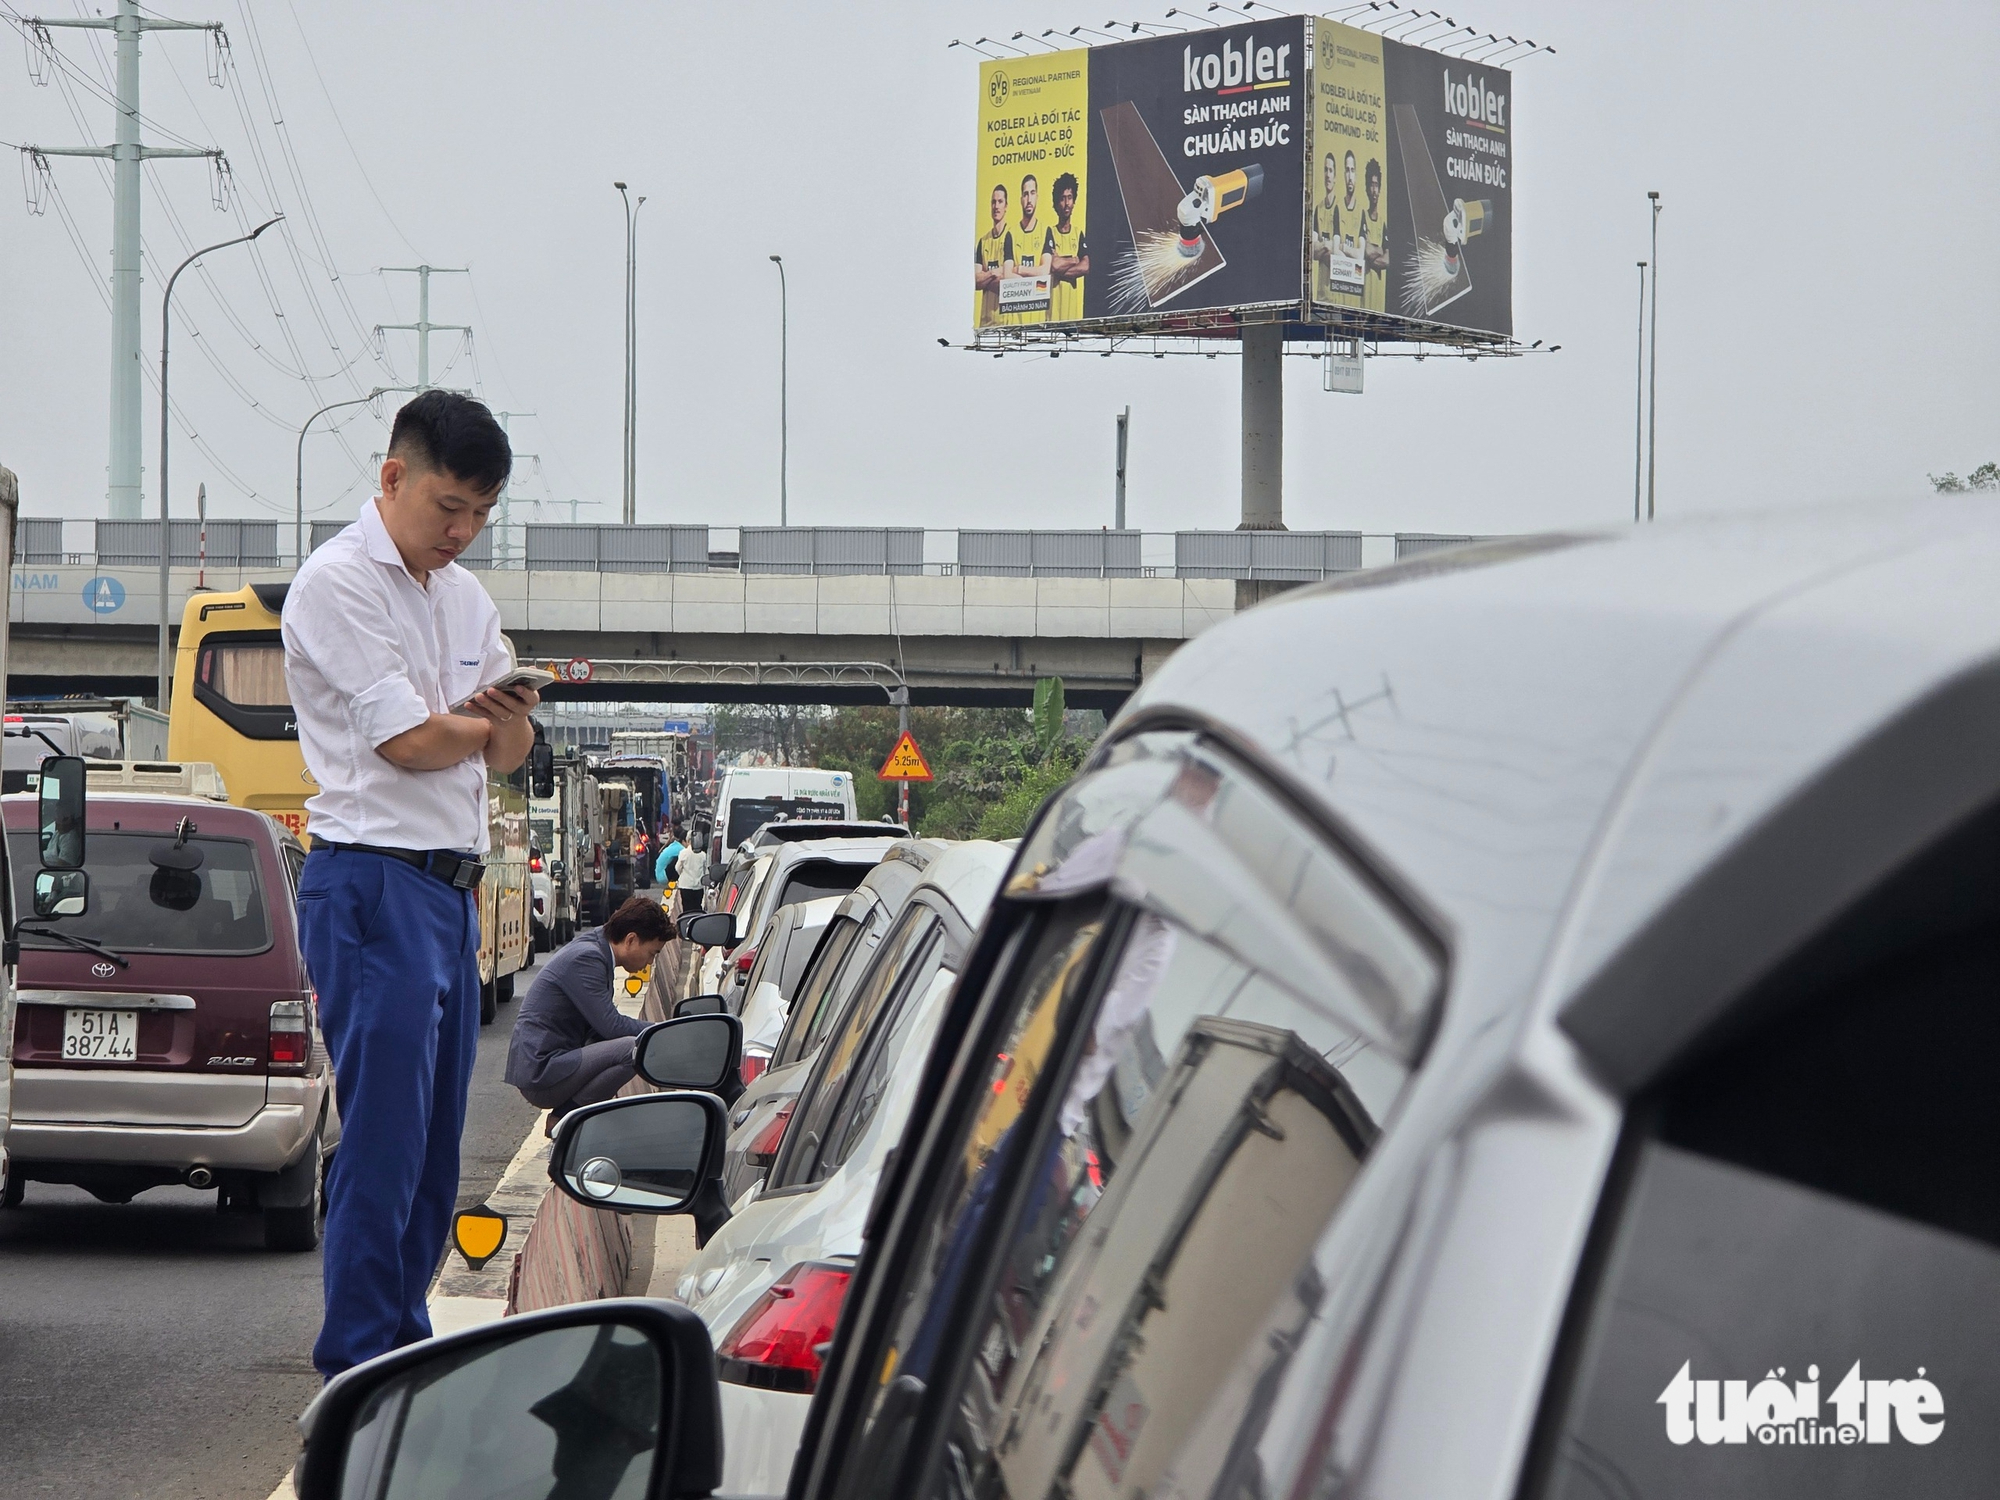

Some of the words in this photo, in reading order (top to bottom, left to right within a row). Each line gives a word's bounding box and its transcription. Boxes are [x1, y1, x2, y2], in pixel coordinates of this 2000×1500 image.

[1184, 35, 1290, 92] kobler
[1012, 75, 1047, 86] REGIONAL
[1048, 70, 1080, 81] PARTNER
[1019, 87, 1041, 95] VIETNAM
[1321, 82, 1346, 99] KOBLER
[1348, 86, 1356, 102] LÀ
[1357, 89, 1368, 105] ĐỐI
[1369, 93, 1381, 108] TÁC
[1444, 68, 1505, 126] kobler
[987, 118, 1025, 132] KOBLER
[1028, 112, 1039, 127] LÀ
[1041, 108, 1059, 125] ĐỐI
[1061, 108, 1080, 122] TÁC
[1184, 104, 1209, 124] SÀN
[1212, 100, 1257, 122] THẠCH
[1260, 96, 1290, 114] ANH
[1326, 98, 1339, 116] CỦA
[1341, 103, 1354, 119] CÂU
[1355, 108, 1367, 124] LẠC
[994, 132, 1014, 148] CỦA
[1017, 131, 1035, 145] CÂU
[1038, 130, 1056, 145] LẠC
[1059, 126, 1072, 142] BỘ
[1184, 123, 1246, 157] CHUẨN
[1249, 118, 1290, 148] ĐỨC
[1324, 119, 1361, 138] DORTMUND
[1366, 128, 1379, 143] ĐỨC
[1446, 127, 1462, 147] SÀN
[1463, 132, 1489, 154] THẠCH
[1490, 140, 1505, 158] ANH
[992, 149, 1046, 166] DORTMUND
[1054, 143, 1074, 158] ĐỨC
[1447, 153, 1482, 183] CHUẨN
[1484, 160, 1506, 188] ĐỨC
[1002, 289, 1032, 298] GERMANY
[14, 574, 58, 589] NAM
[895, 756, 920, 766] 5.25m
[82, 1012, 118, 1035] 51A
[66, 1035, 133, 1057] 387.44
